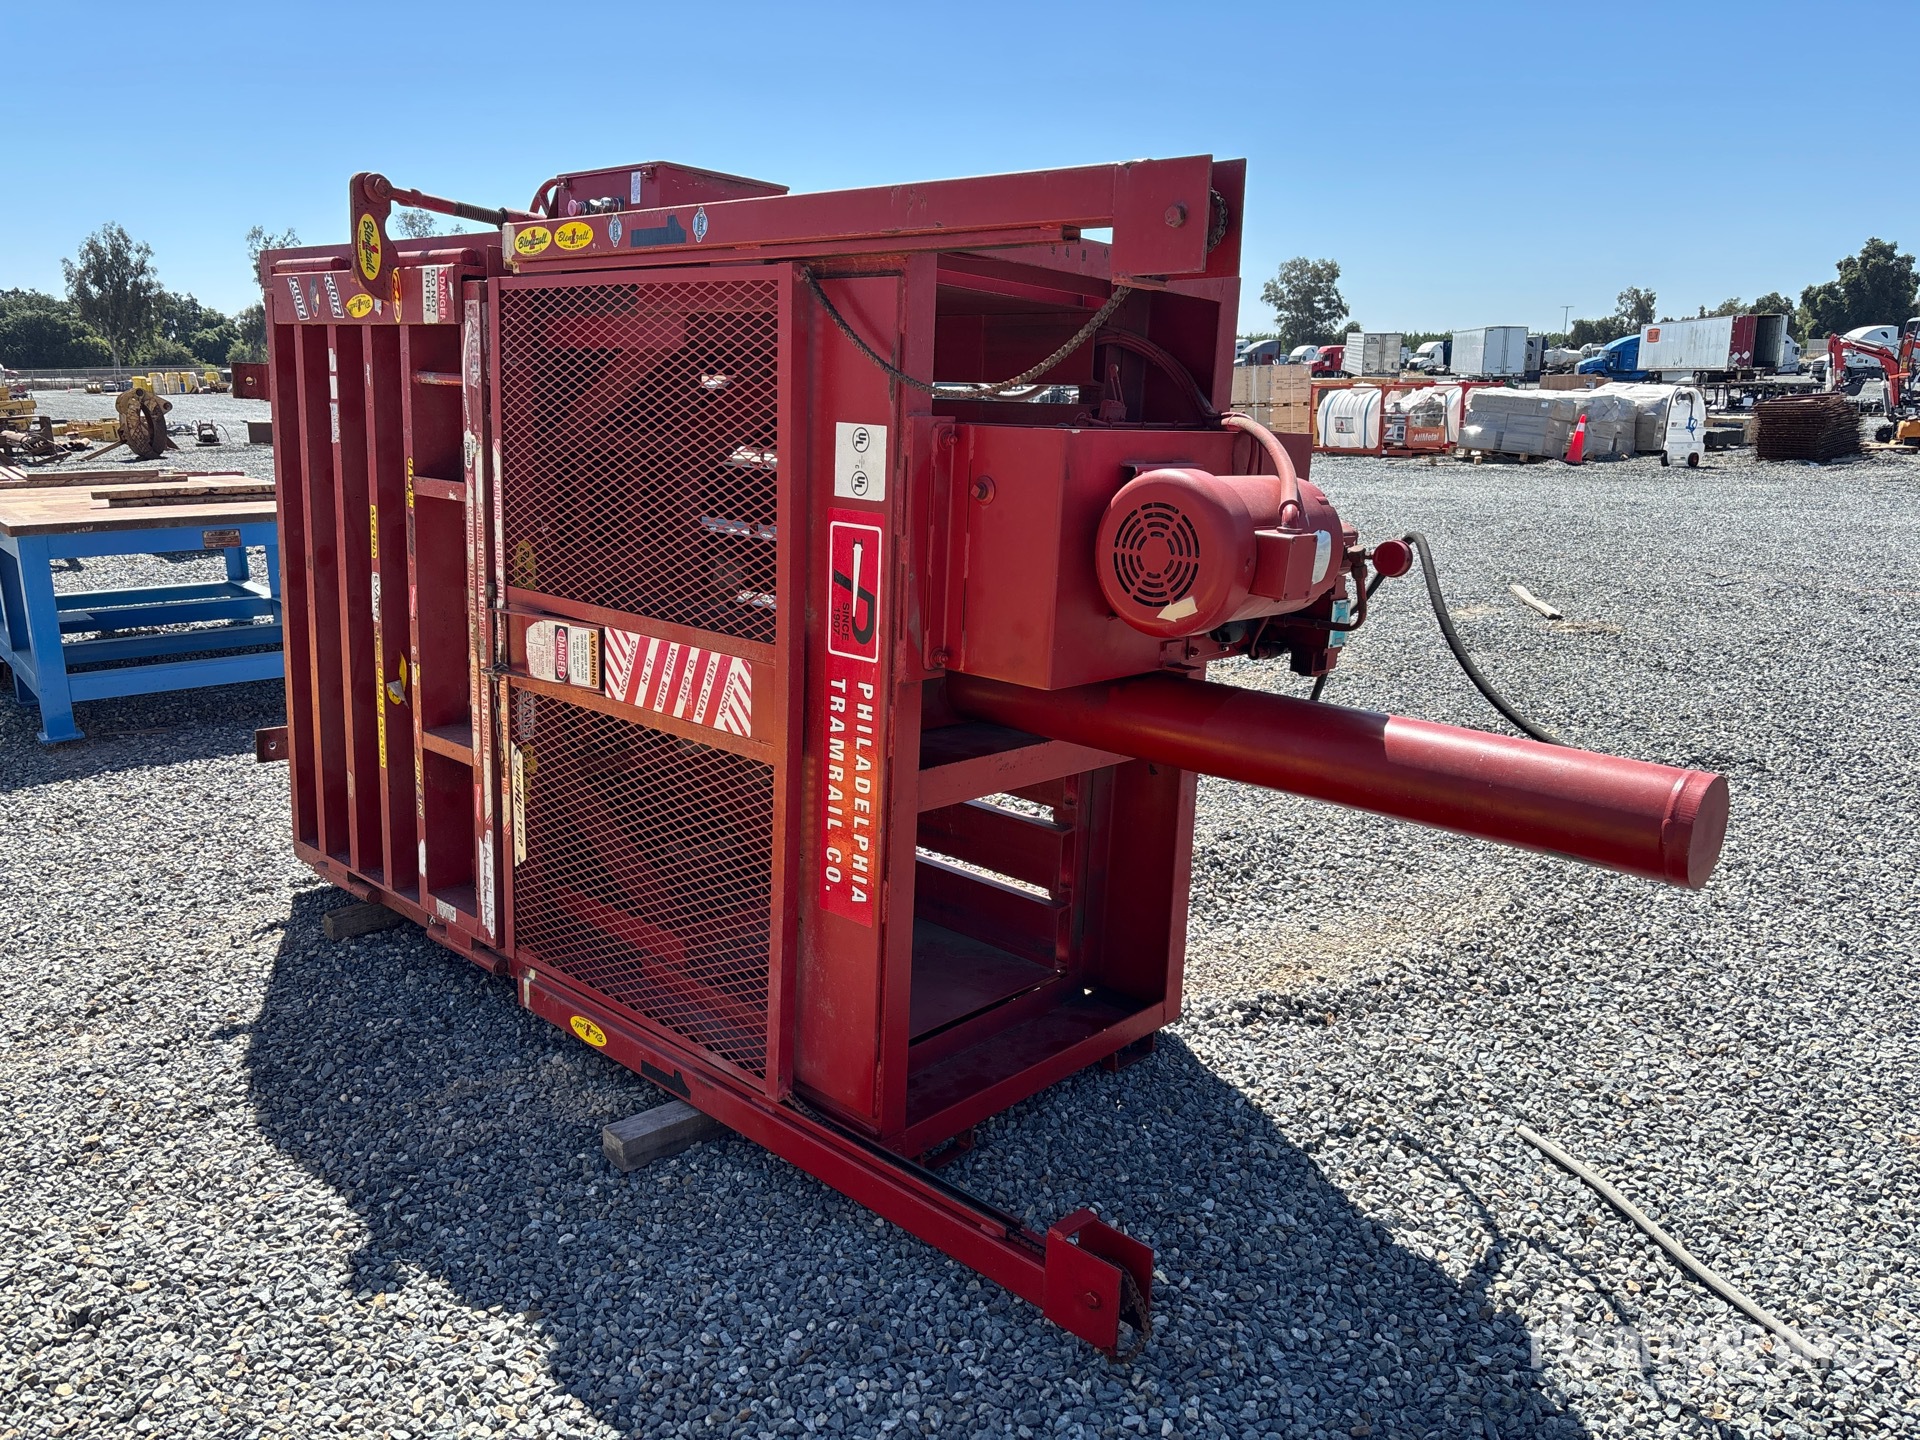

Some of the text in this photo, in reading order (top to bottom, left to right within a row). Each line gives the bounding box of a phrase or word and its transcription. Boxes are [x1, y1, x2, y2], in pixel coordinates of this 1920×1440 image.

[326, 274, 343, 315] KLOTZ
[430, 269, 436, 286] DO
[290, 281, 308, 317] KLOTZ
[855, 432, 867, 448] UL
[1413, 432, 1440, 442] AllMetal
[493, 479, 501, 520] CAUTION
[854, 476, 866, 491] UL
[833, 607, 841, 636] 1907
[842, 602, 850, 641] SINCE
[557, 636, 565, 673] DANGER
[619, 640, 637, 695] OPERATION
[642, 657, 652, 685] IS IN
[656, 647, 676, 708] WHILE BALER
[680, 659, 696, 701] OF GATE
[696, 660, 716, 718] KEEP CLEAR
[719, 672, 736, 718] CAUTION
[481, 698, 488, 709] AS
[482, 712, 490, 754] POSSIBLE
[825, 678, 847, 891] TRAMRAIL CO.
[851, 681, 874, 902] PHILADELPHIA
